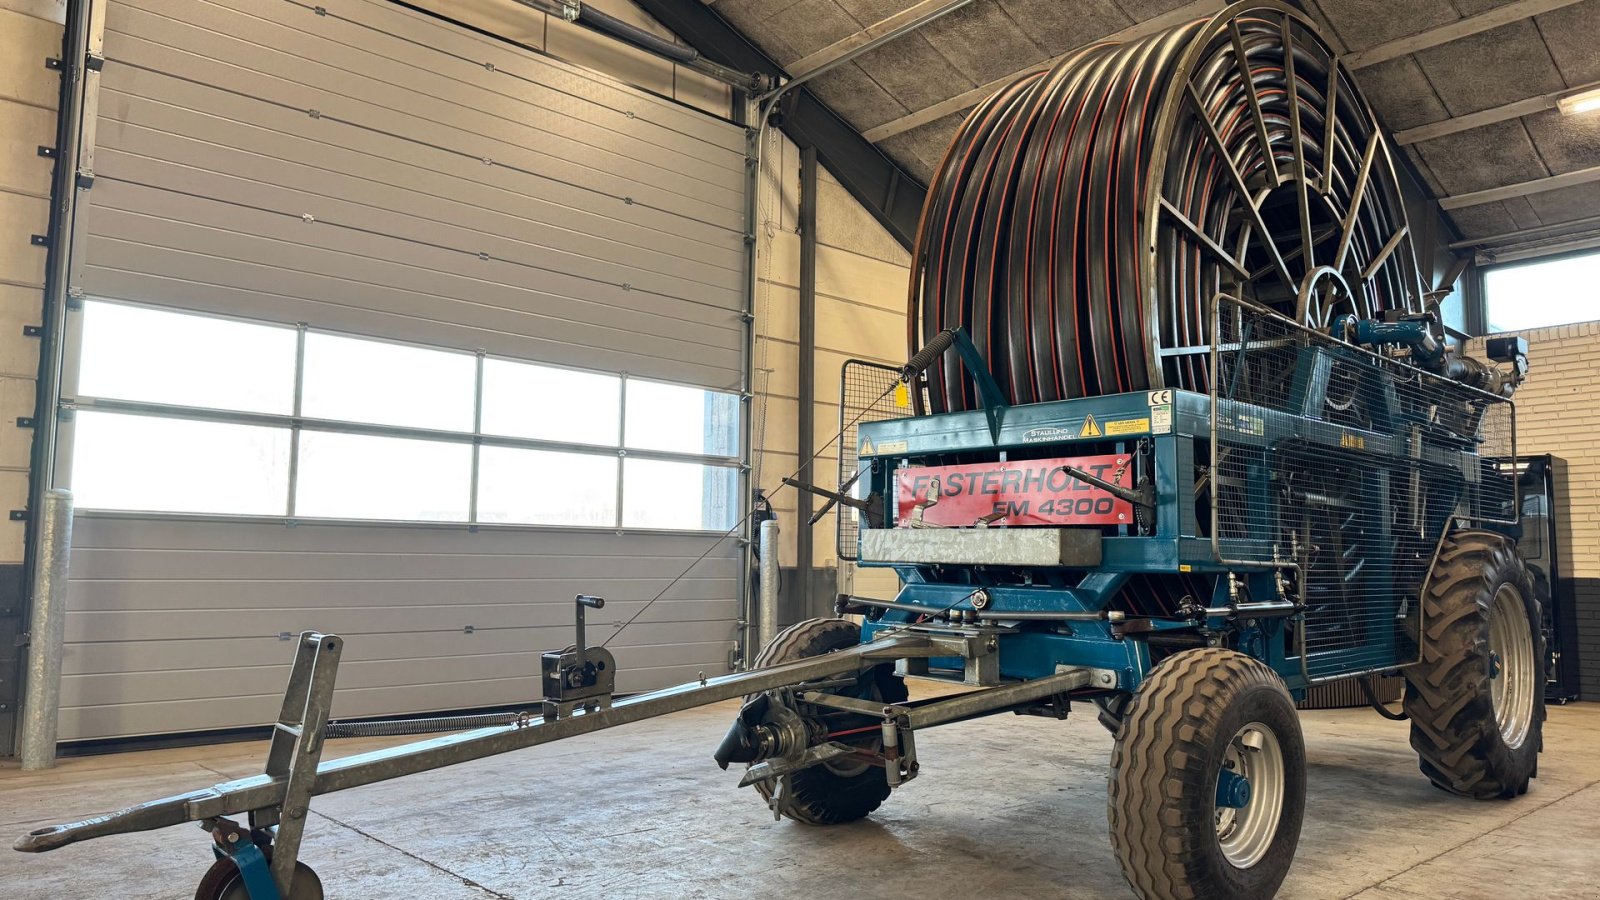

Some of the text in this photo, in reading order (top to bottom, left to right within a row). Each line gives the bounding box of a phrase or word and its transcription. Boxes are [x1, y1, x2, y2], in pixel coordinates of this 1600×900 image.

[1151, 391, 1169, 404] CE
[1030, 428, 1069, 437] STAULUND
[1023, 434, 1078, 443] MASKINHANDEL
[1038, 497, 1114, 516] 4300
